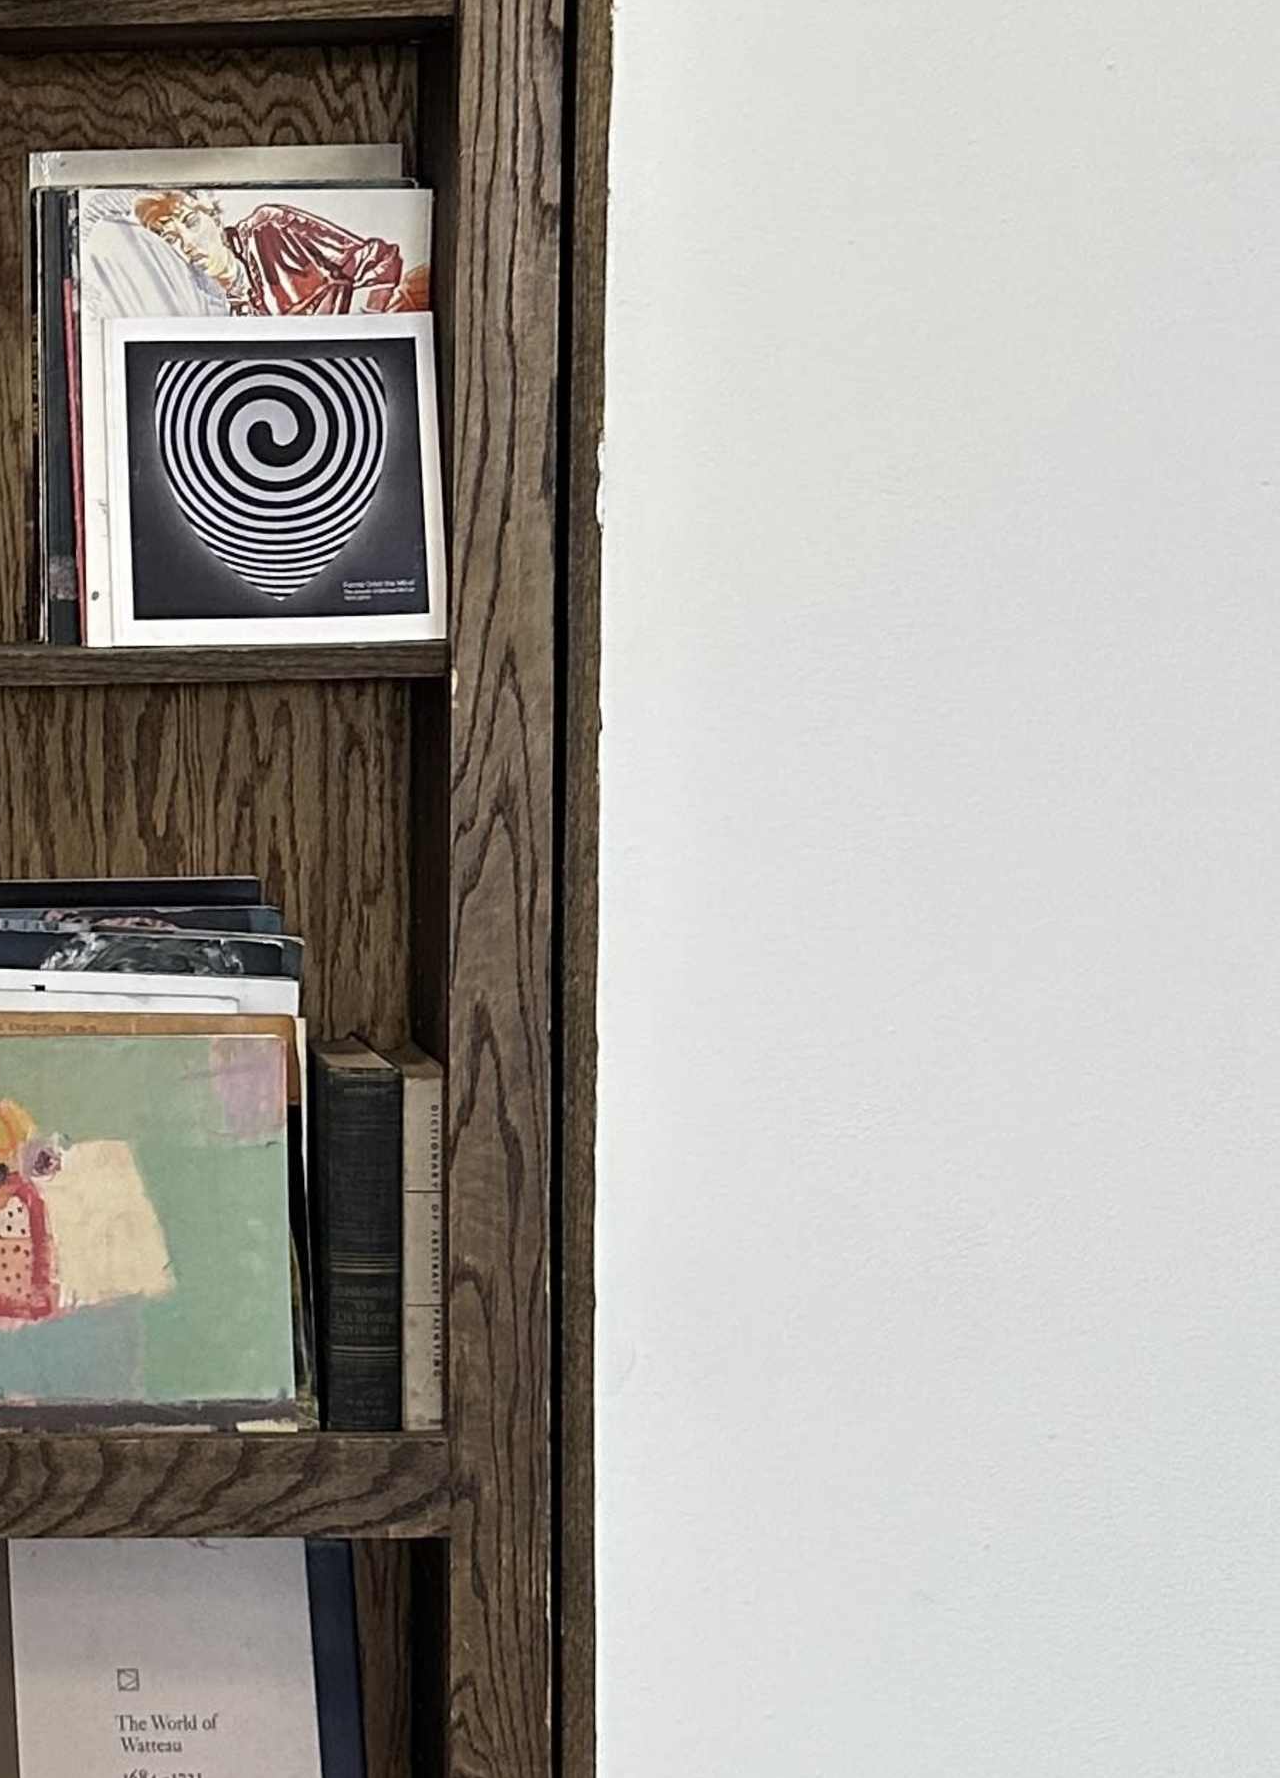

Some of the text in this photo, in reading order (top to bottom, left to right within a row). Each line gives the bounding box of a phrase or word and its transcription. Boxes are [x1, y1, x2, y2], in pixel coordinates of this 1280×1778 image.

[430, 1104, 440, 1189] DICTIONARY
[115, 1712, 220, 1732] The World of
[121, 1737, 183, 1754] Watteau
